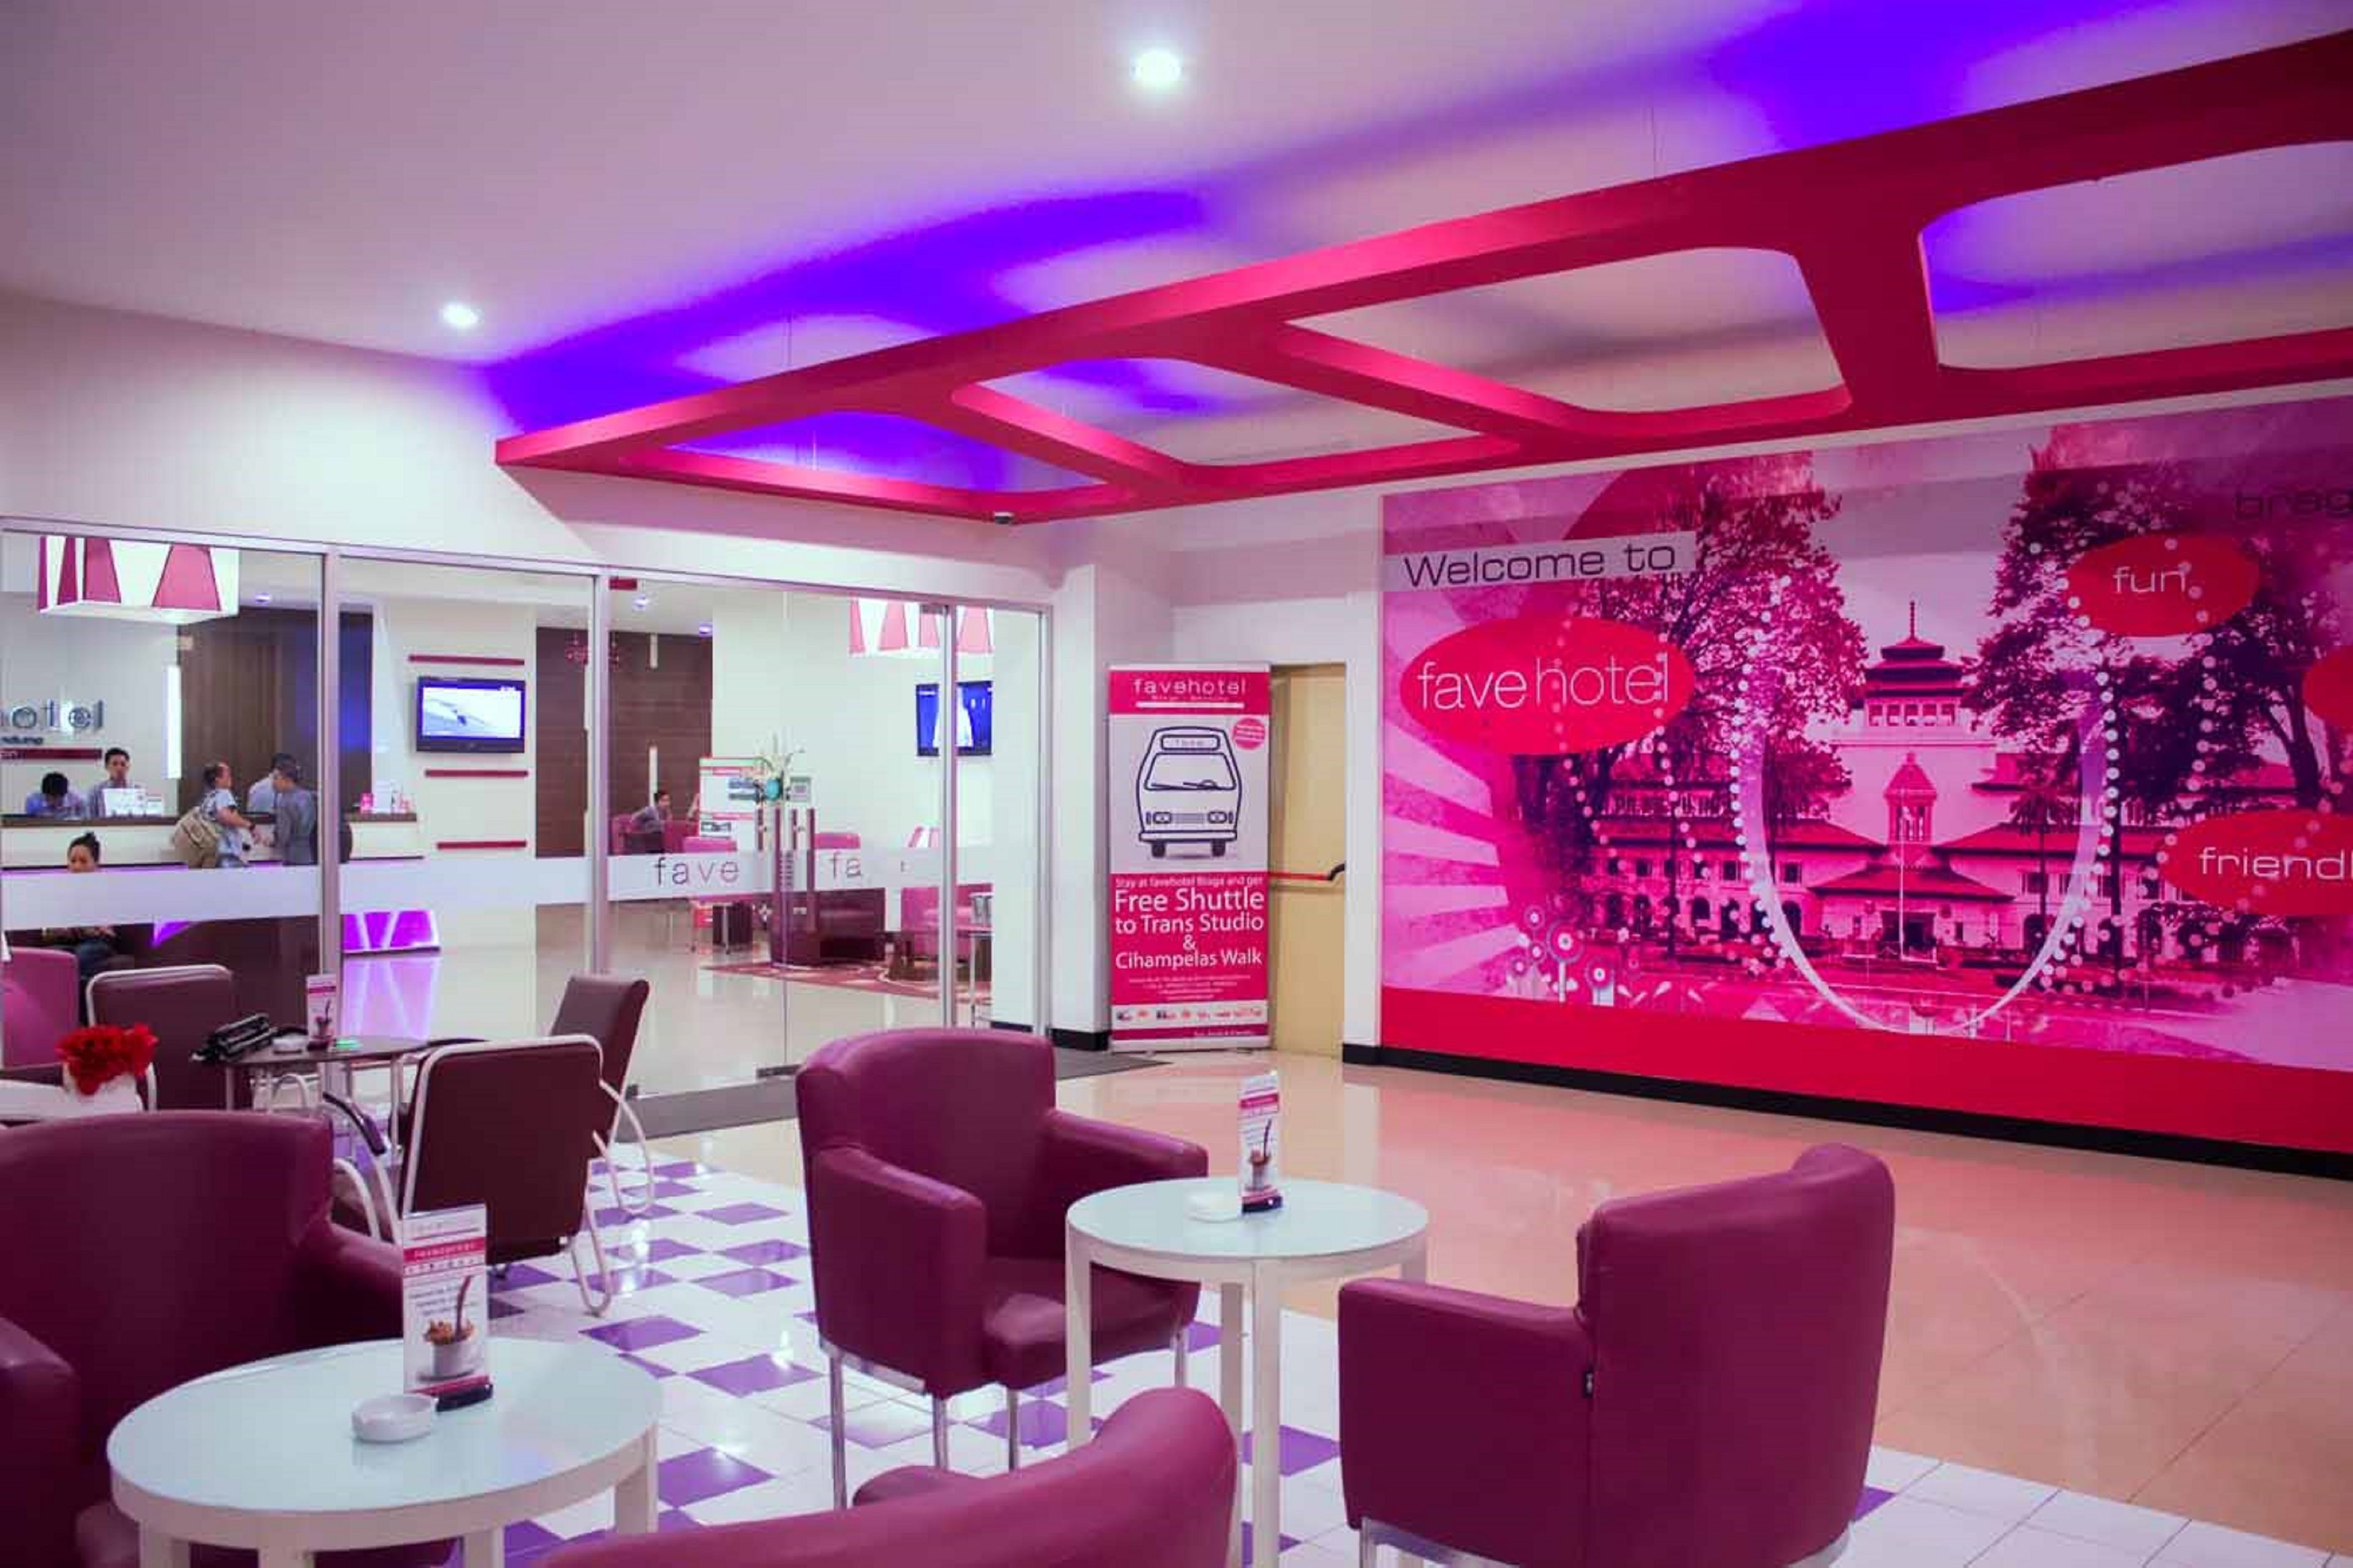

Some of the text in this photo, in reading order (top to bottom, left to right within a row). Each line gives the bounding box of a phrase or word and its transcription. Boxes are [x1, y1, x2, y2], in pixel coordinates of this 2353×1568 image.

[1404, 543, 1676, 587] Welcome to
[2112, 565, 2187, 593] fun
[1133, 678, 1246, 695] favehotel
[1417, 652, 1669, 710] favehotel
[654, 857, 740, 887] fave
[1115, 887, 1264, 912] Free Shuttle
[1115, 911, 1264, 934] to Trans Studio
[1183, 934, 1196, 950] &
[1115, 947, 1262, 971] Cihampelas Walk
